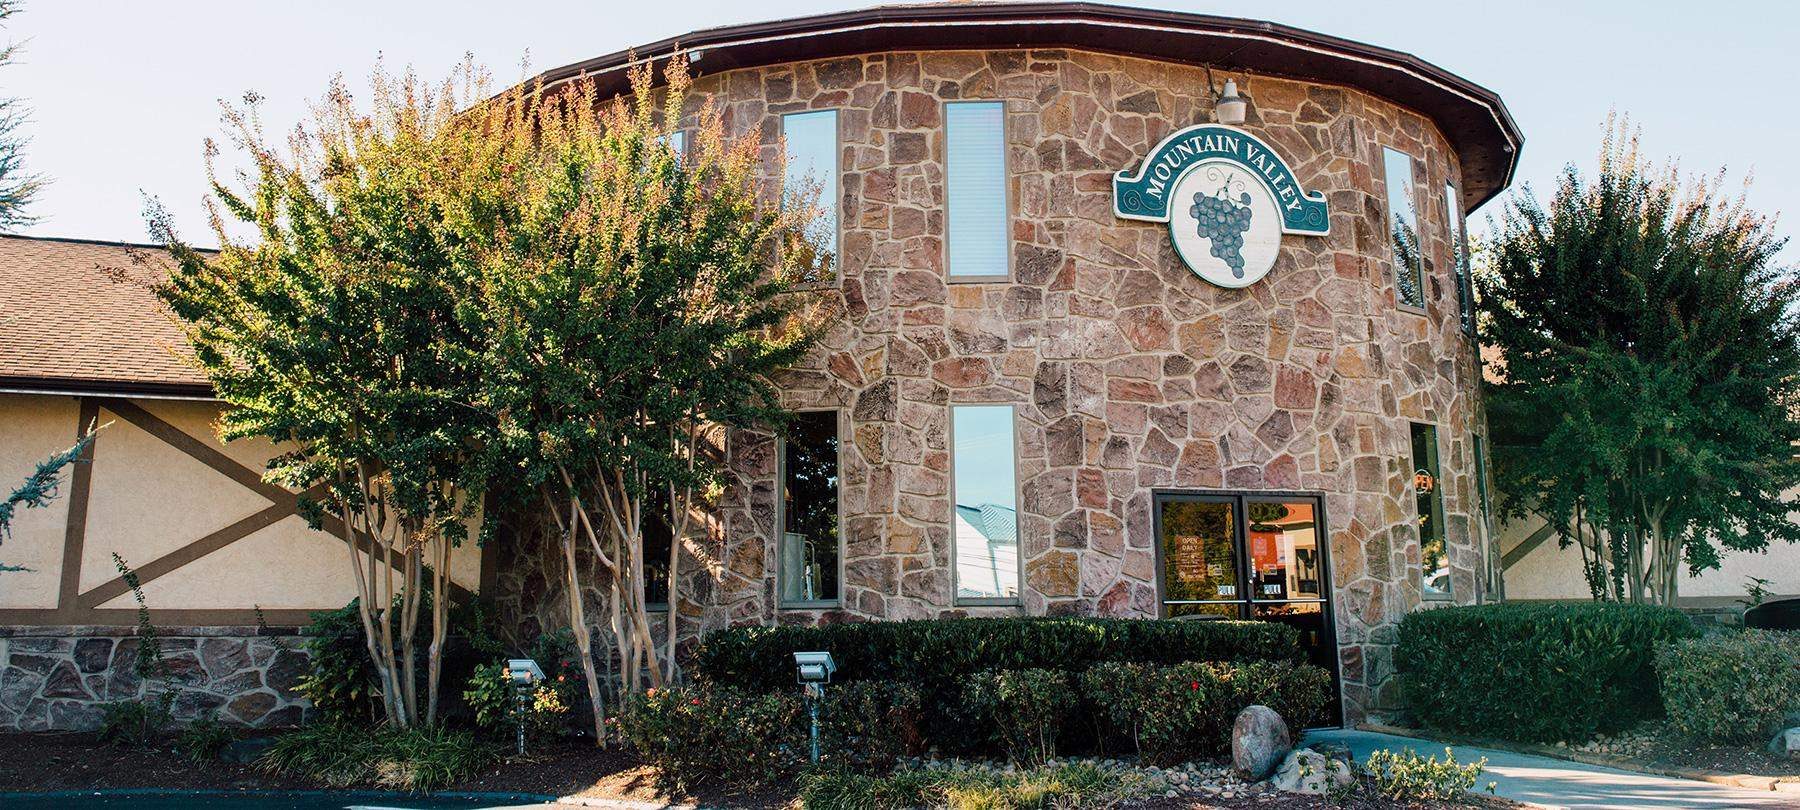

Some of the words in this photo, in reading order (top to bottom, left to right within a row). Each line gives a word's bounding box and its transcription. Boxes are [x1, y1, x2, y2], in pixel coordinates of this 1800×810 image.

[1146, 135, 1239, 199] MOUNTAIN
[1246, 142, 1302, 211] VALLEY
[1414, 474, 1433, 490] PEN
[1263, 584, 1281, 595] PULL
